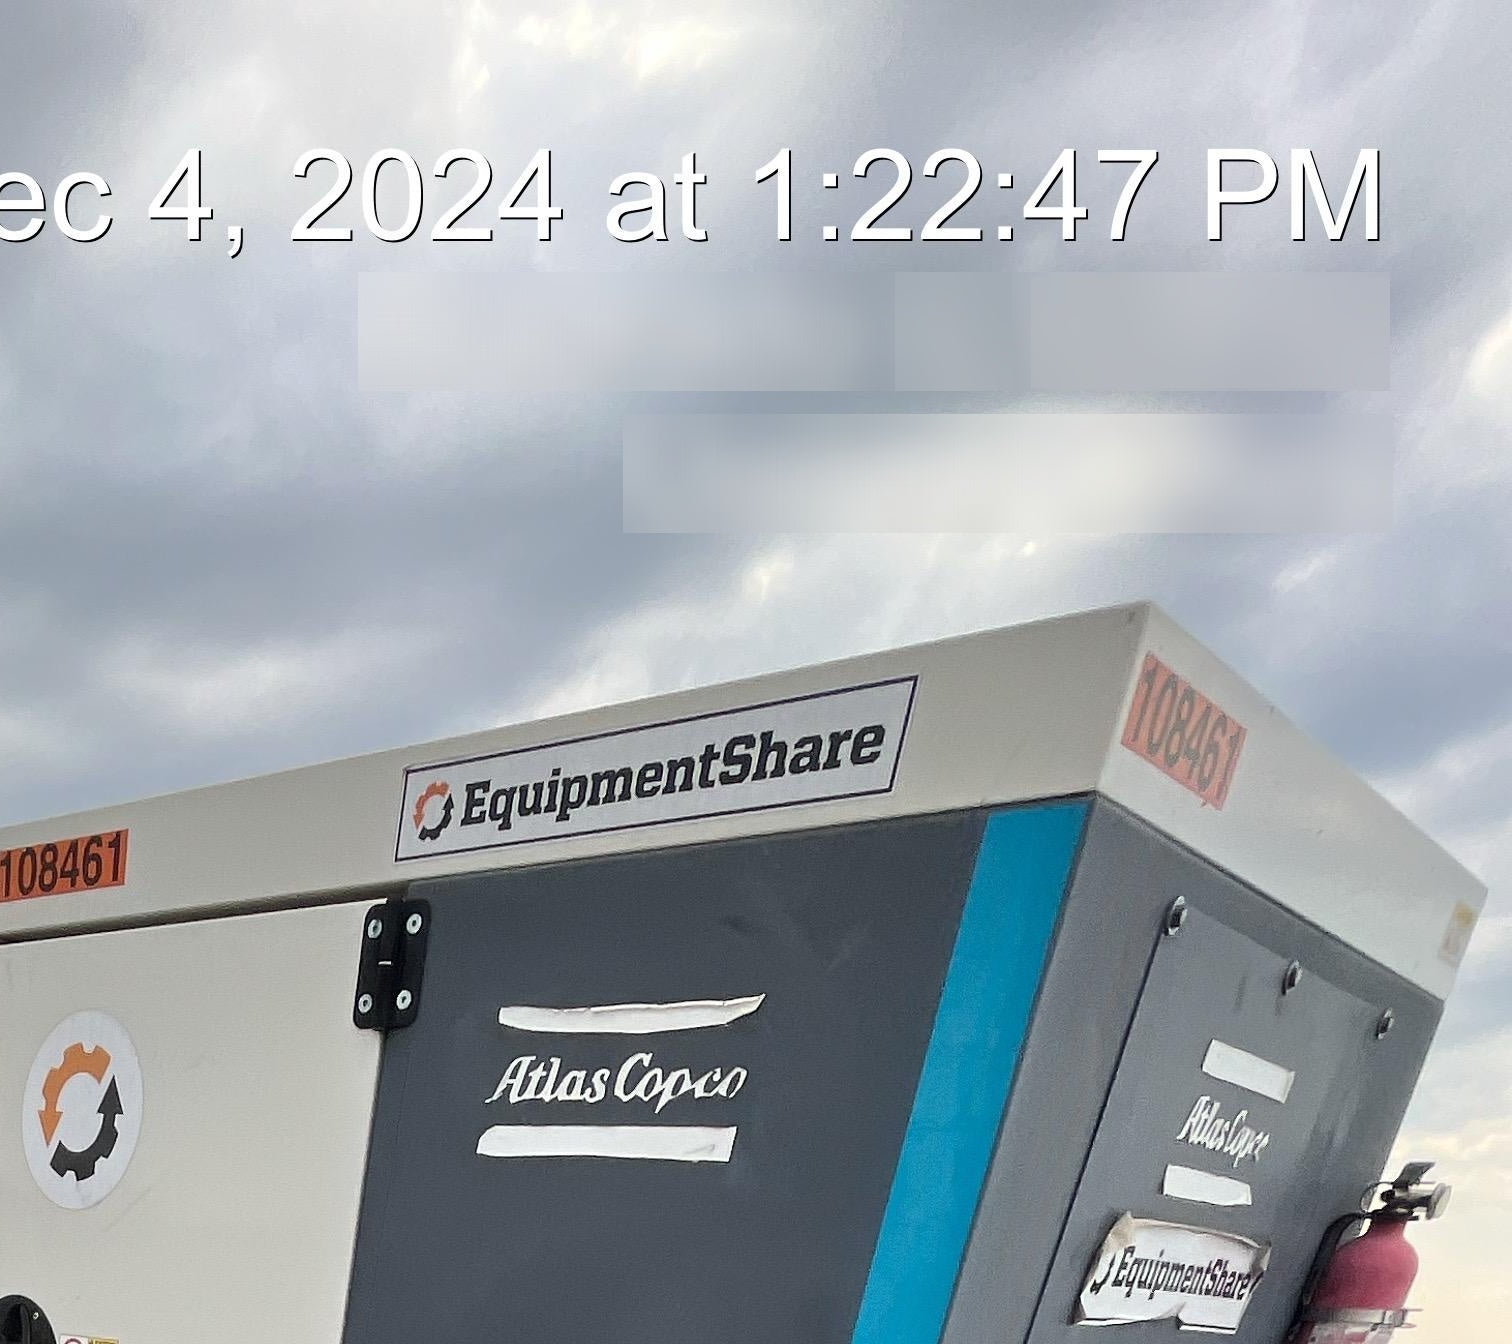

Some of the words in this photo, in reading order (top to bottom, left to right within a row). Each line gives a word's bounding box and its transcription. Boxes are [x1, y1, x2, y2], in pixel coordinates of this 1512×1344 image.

[1131, 661, 1240, 801] 108461
[459, 722, 885, 832] EquipmentShare
[0, 830, 122, 898] 108461
[484, 1055, 611, 1105] Atlas
[613, 1052, 749, 1115] Copco
[1175, 1095, 1231, 1151] Atlas
[1110, 1245, 1252, 1301] EquipmentShare
